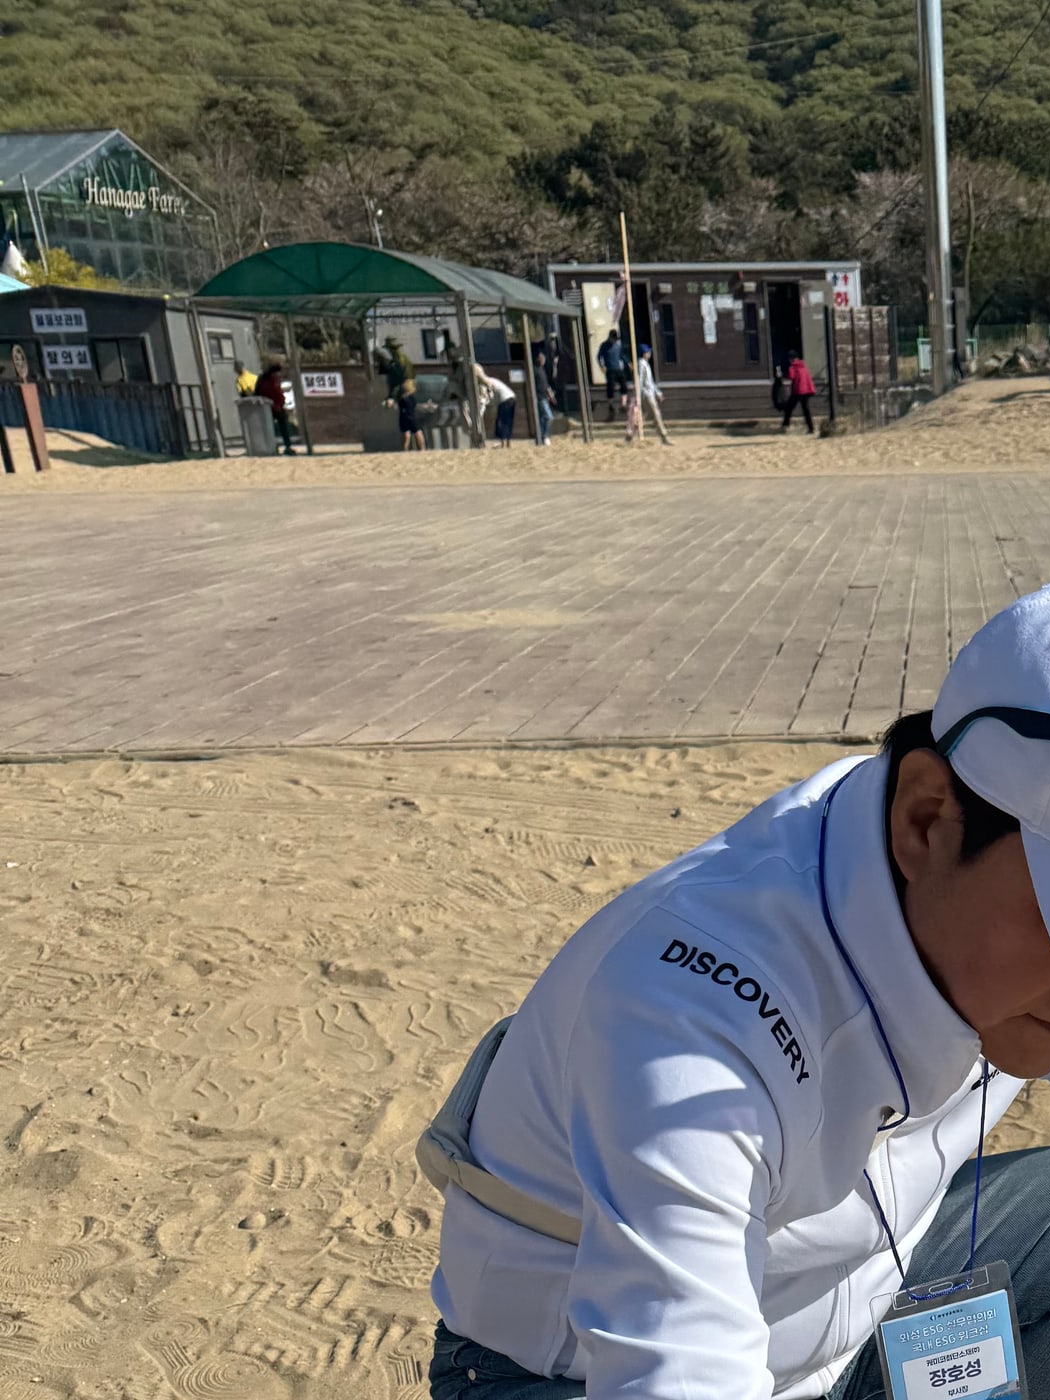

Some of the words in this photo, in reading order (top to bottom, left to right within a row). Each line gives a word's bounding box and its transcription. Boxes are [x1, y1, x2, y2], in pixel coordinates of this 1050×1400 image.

[84, 176, 146, 218] Hanagae
[659, 939, 810, 1085] DISCOVERY
[912, 1340, 933, 1352] 국내
[935, 1333, 955, 1347] ESG
[923, 1323, 944, 1337] ESG
[929, 1358, 982, 1388] 장호성
